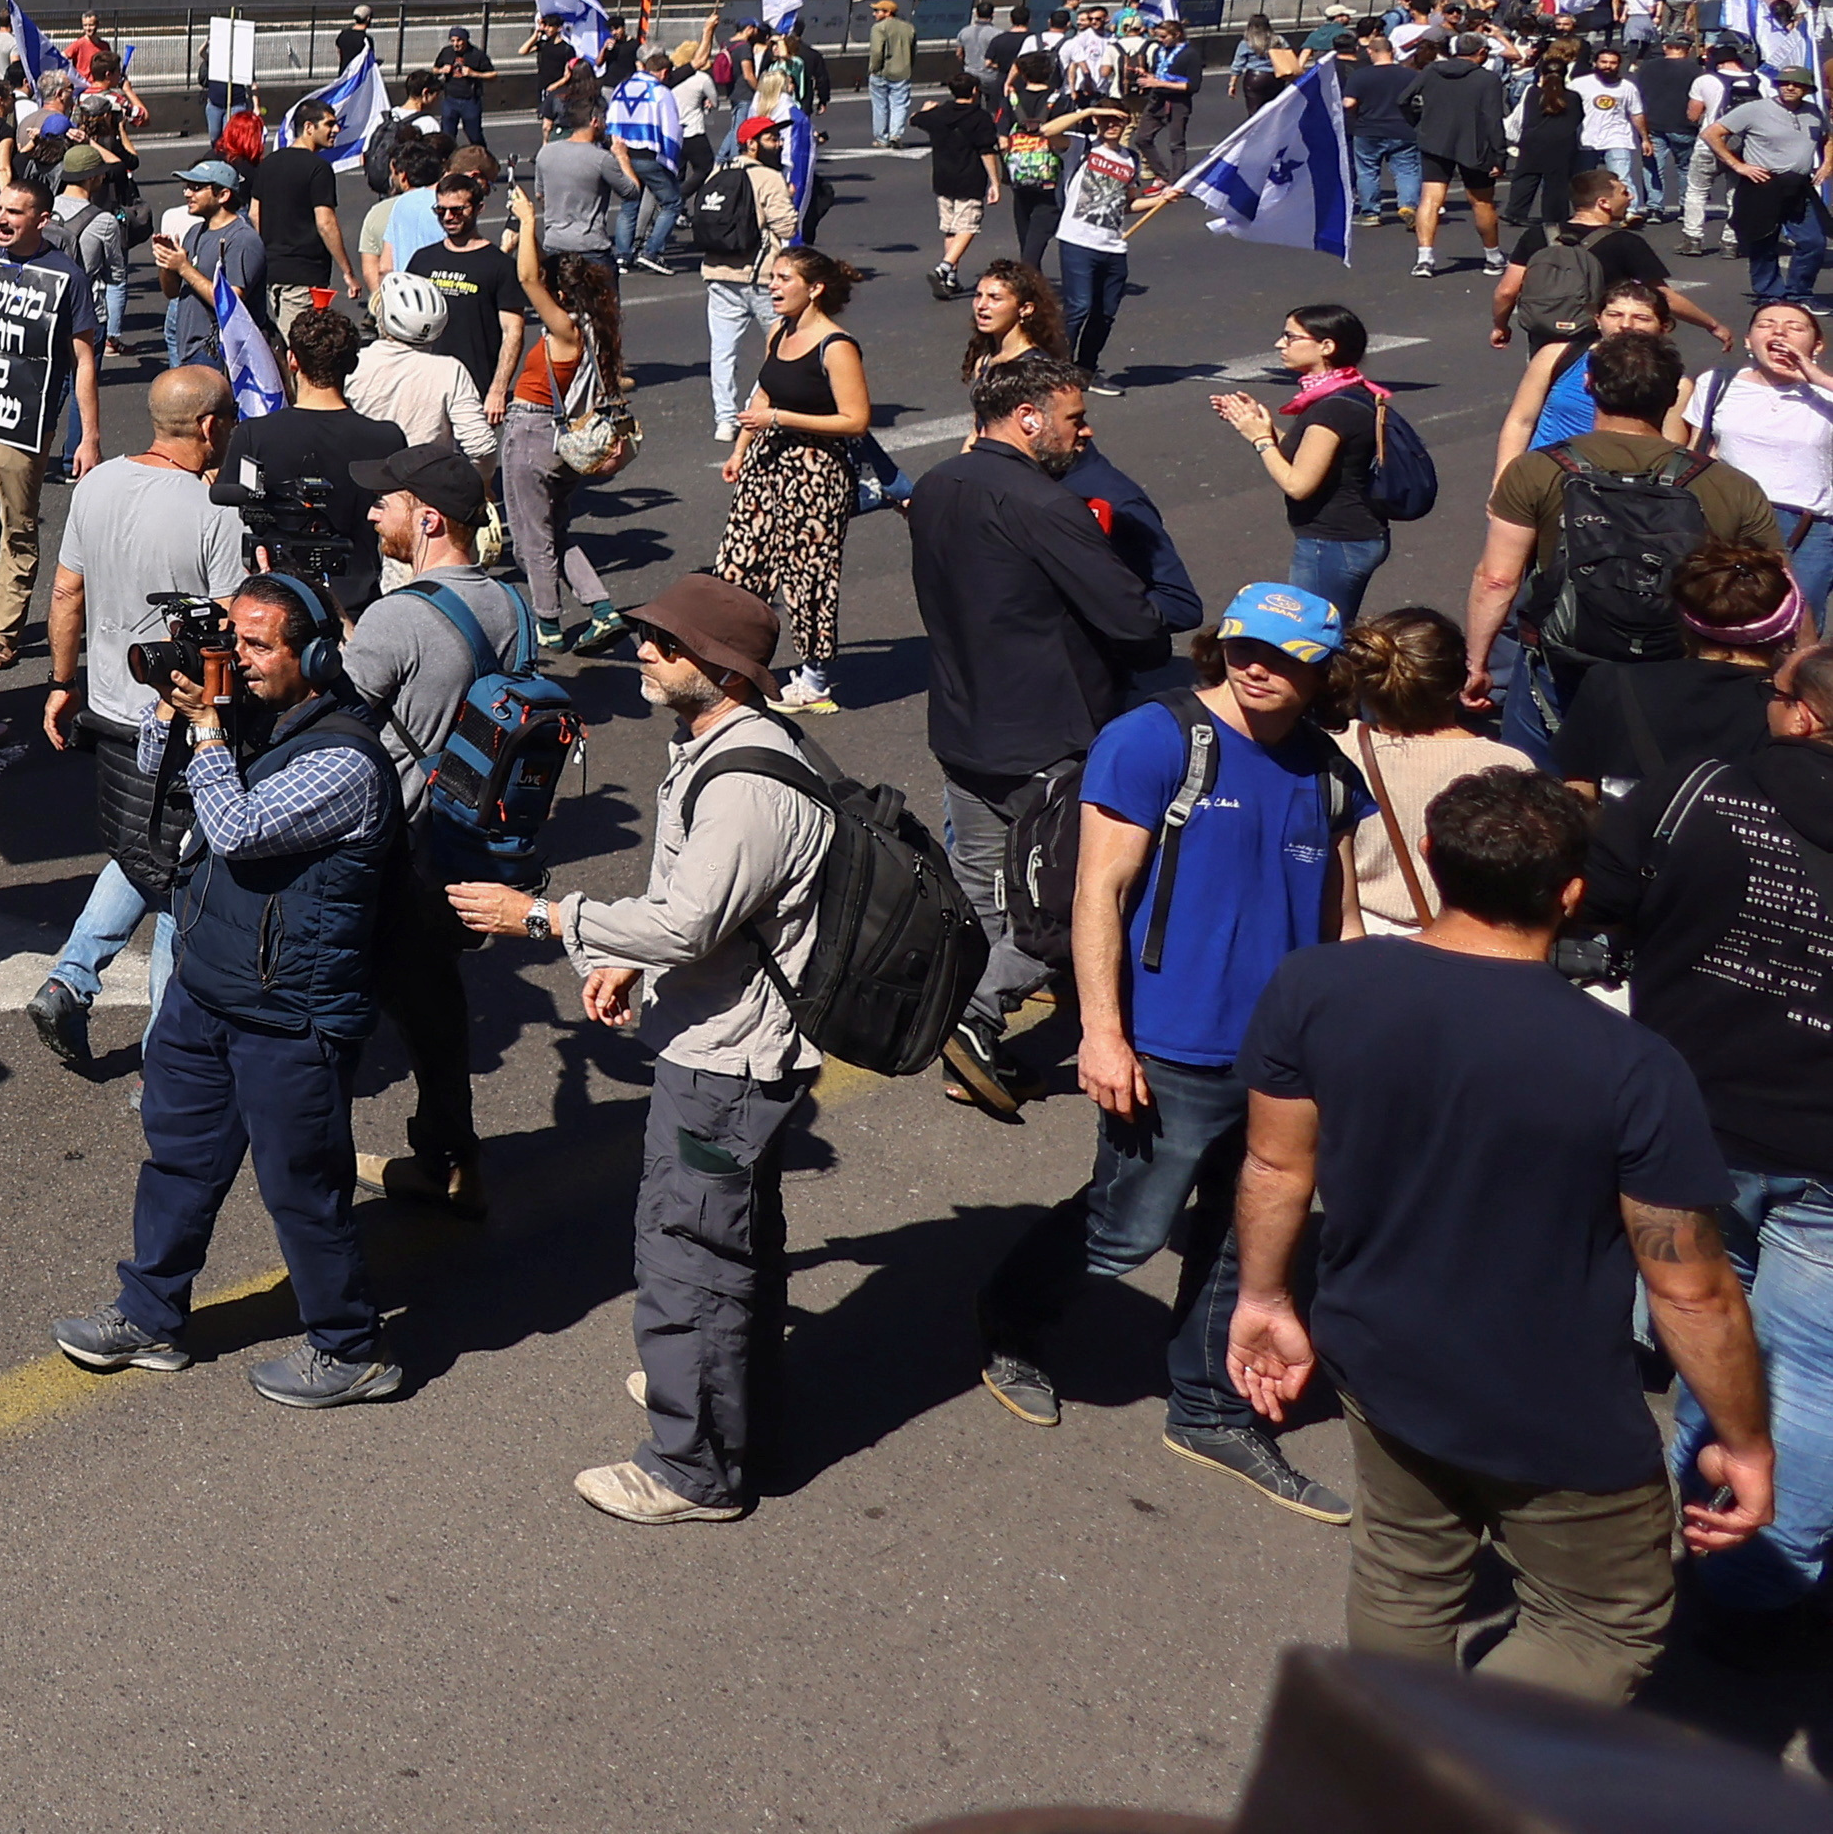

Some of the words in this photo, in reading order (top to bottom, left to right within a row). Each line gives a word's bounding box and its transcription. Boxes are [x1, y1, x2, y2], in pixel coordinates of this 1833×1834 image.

[1257, 603, 1302, 623] SUBARU
[1703, 794, 1780, 815] Mountai
[1731, 824, 1796, 847] landsc
[1749, 875, 1793, 892] giving
[1748, 886, 1803, 905] scenery
[1746, 897, 1787, 912] effect
[1793, 909, 1818, 919] and
[1703, 954, 1742, 971] know
[1744, 967, 1773, 981] that
[1780, 977, 1817, 993] your
[1787, 1011, 1802, 1022] as
[1807, 1017, 1831, 1031] the
